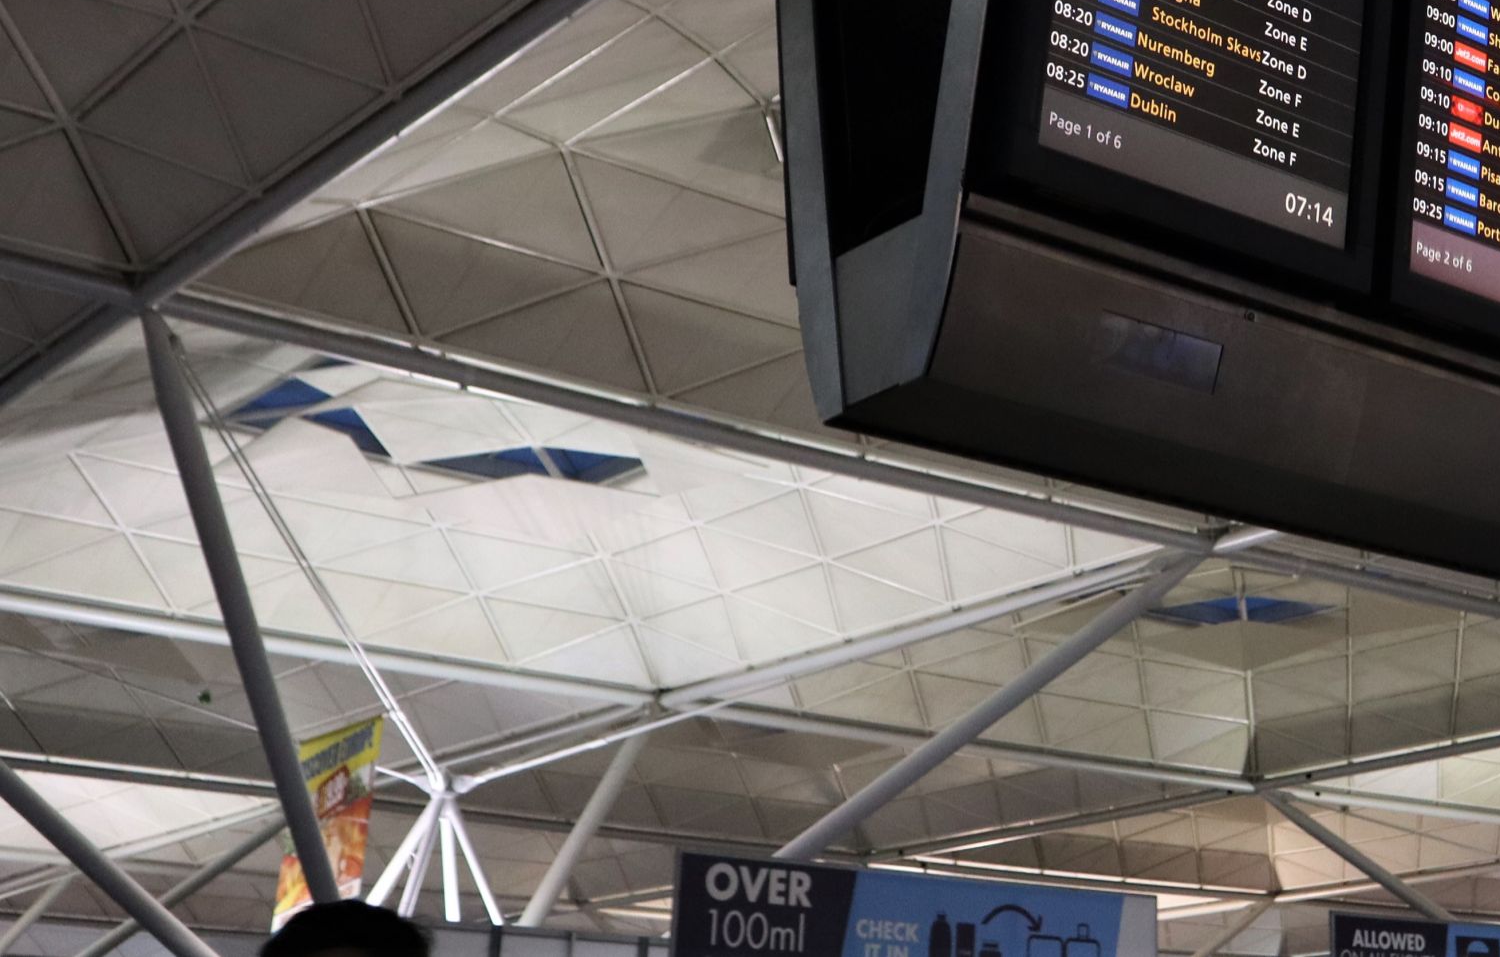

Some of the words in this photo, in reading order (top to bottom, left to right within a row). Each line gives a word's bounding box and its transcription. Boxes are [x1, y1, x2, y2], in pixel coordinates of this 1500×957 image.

[1302, 7, 1311, 22] D
[1264, 21, 1296, 46] Zone
[1299, 36, 1307, 51] E
[1424, 31, 1453, 54] 09:00
[1054, 0, 1092, 26] 08:20
[1137, 31, 1215, 77] Nuremberg
[1258, 78, 1291, 104] Zone
[1294, 93, 1302, 107] F
[1050, 30, 1089, 57] 08:20
[1134, 61, 1194, 97] Wroclaw
[1255, 108, 1288, 133] Zone
[1292, 122, 1300, 138] E
[1046, 61, 1085, 88] 08:25
[1130, 92, 1176, 122] Dublin
[1252, 137, 1285, 163] Zone
[1289, 151, 1296, 166] F
[1049, 110, 1081, 135] Page
[1086, 124, 1091, 138] 1
[1096, 130, 1111, 145] of
[1113, 134, 1121, 149] 6
[1285, 192, 1333, 226] 07:14
[1412, 197, 1442, 220] 09:25
[1416, 240, 1441, 262] Page
[1443, 250, 1450, 265] 2
[1452, 254, 1464, 269] of
[1465, 258, 1472, 272] 6
[705, 862, 813, 909] OVER
[708, 909, 806, 953] 100ml
[856, 919, 920, 942] CHECK
[1352, 929, 1426, 952] ALLOWED
